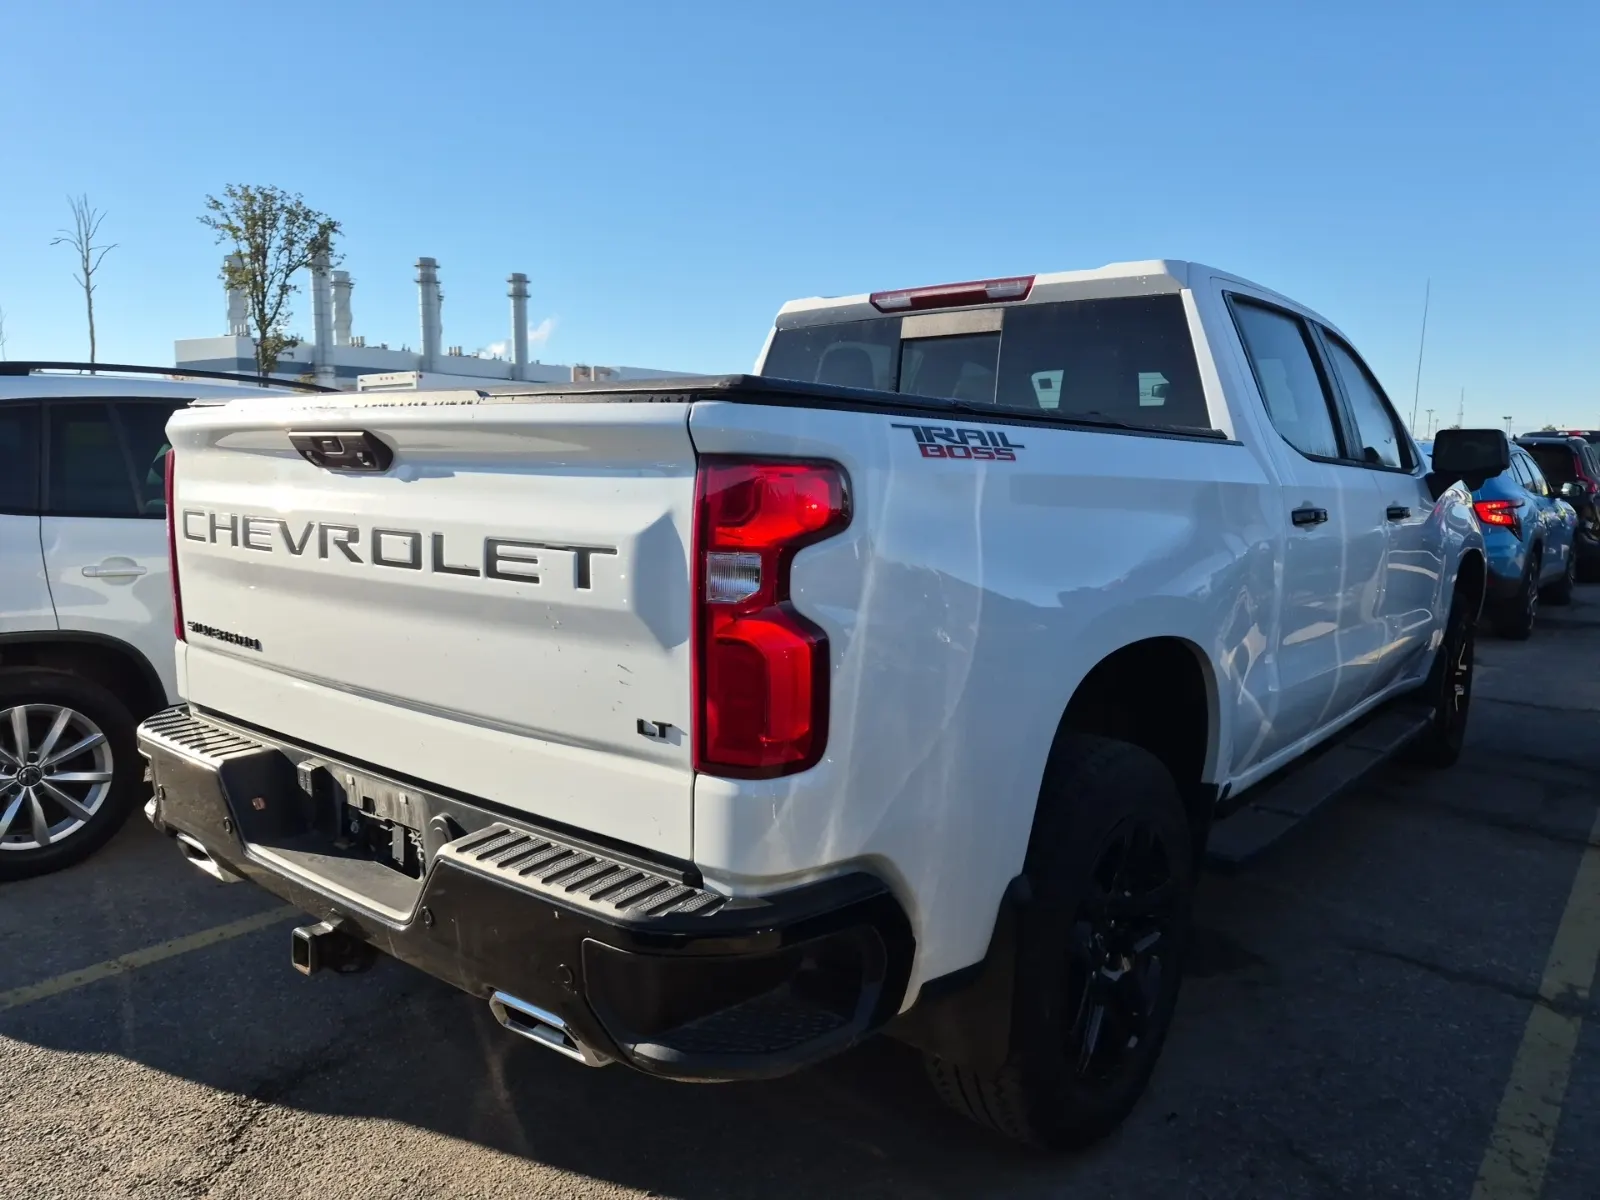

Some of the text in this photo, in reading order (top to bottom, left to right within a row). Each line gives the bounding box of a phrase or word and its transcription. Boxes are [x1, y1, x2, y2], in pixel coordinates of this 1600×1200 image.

[890, 423, 1025, 448] TRAIL
[918, 443, 1016, 461] BOSS
[183, 509, 618, 589] CHEVROLET
[637, 718, 672, 738] LT
